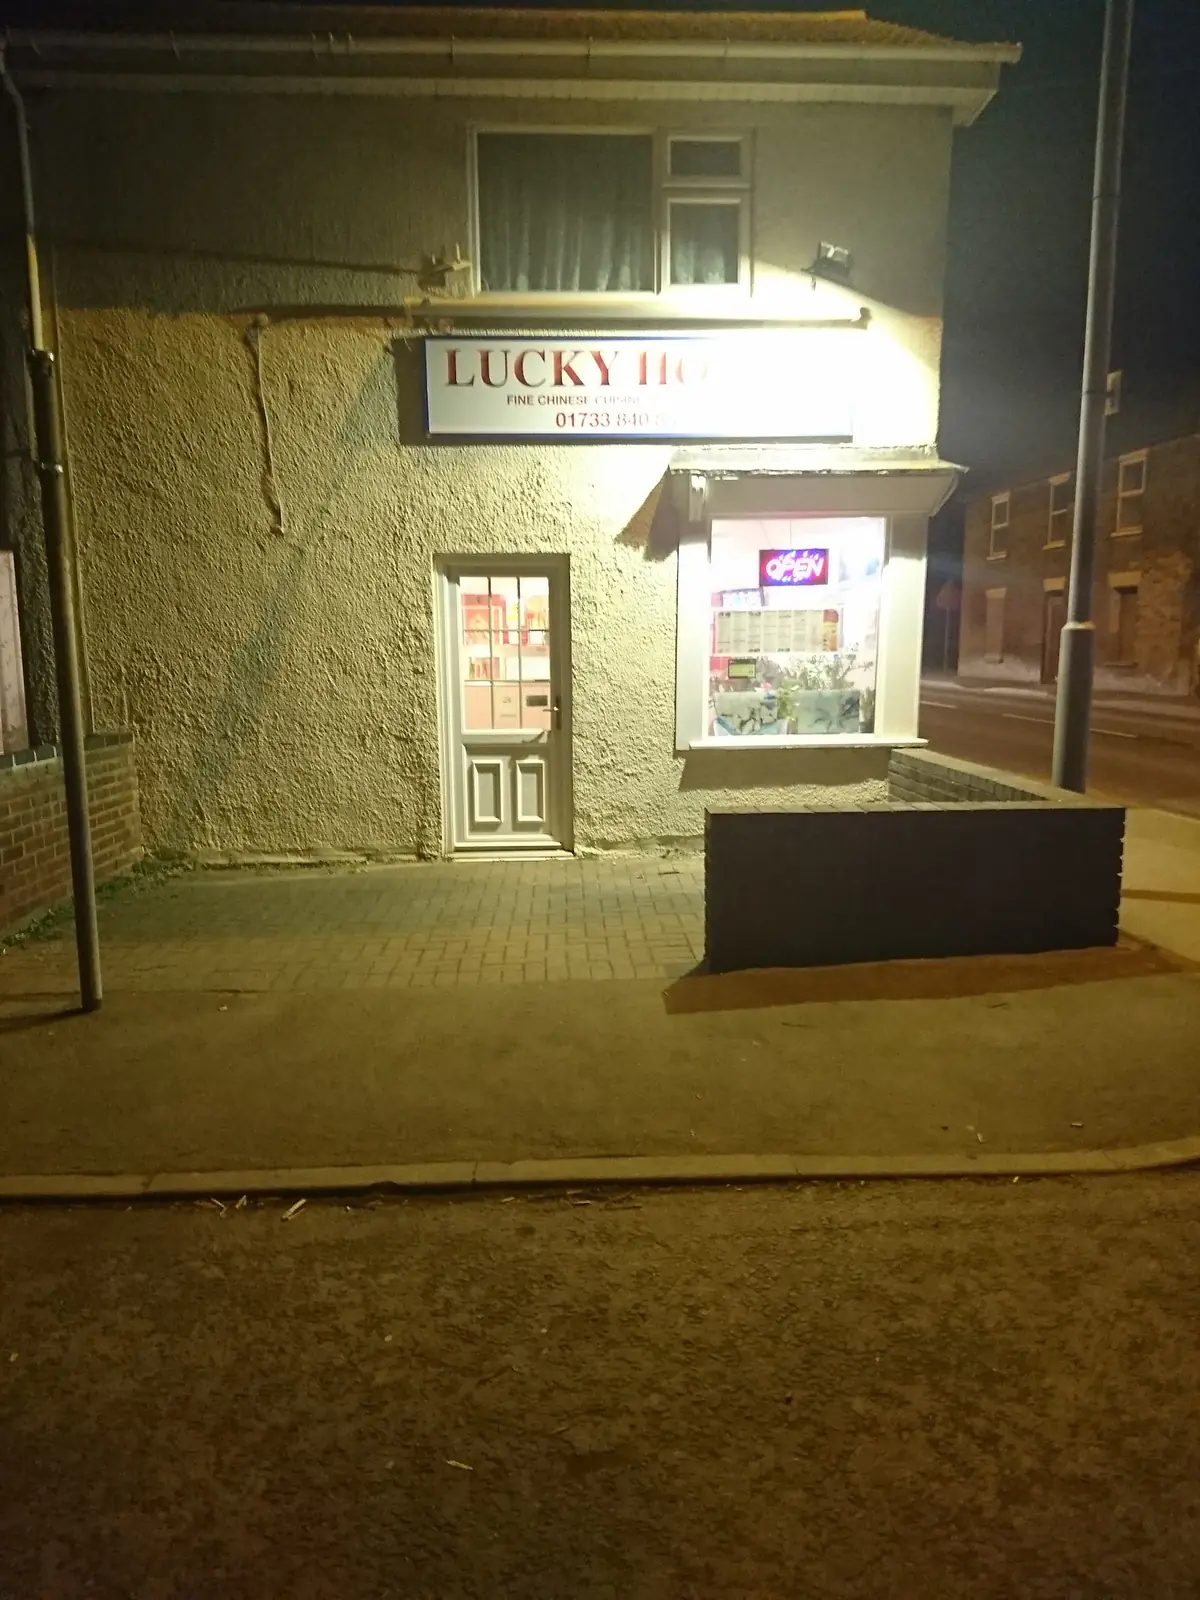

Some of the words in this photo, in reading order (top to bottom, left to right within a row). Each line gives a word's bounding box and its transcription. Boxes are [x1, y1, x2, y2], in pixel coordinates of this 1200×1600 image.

[445, 348, 619, 388] LUCKY
[506, 394, 535, 406] FINE
[537, 394, 590, 406] CHINESE
[556, 411, 611, 428] 01733
[765, 554, 825, 579] OPEN
